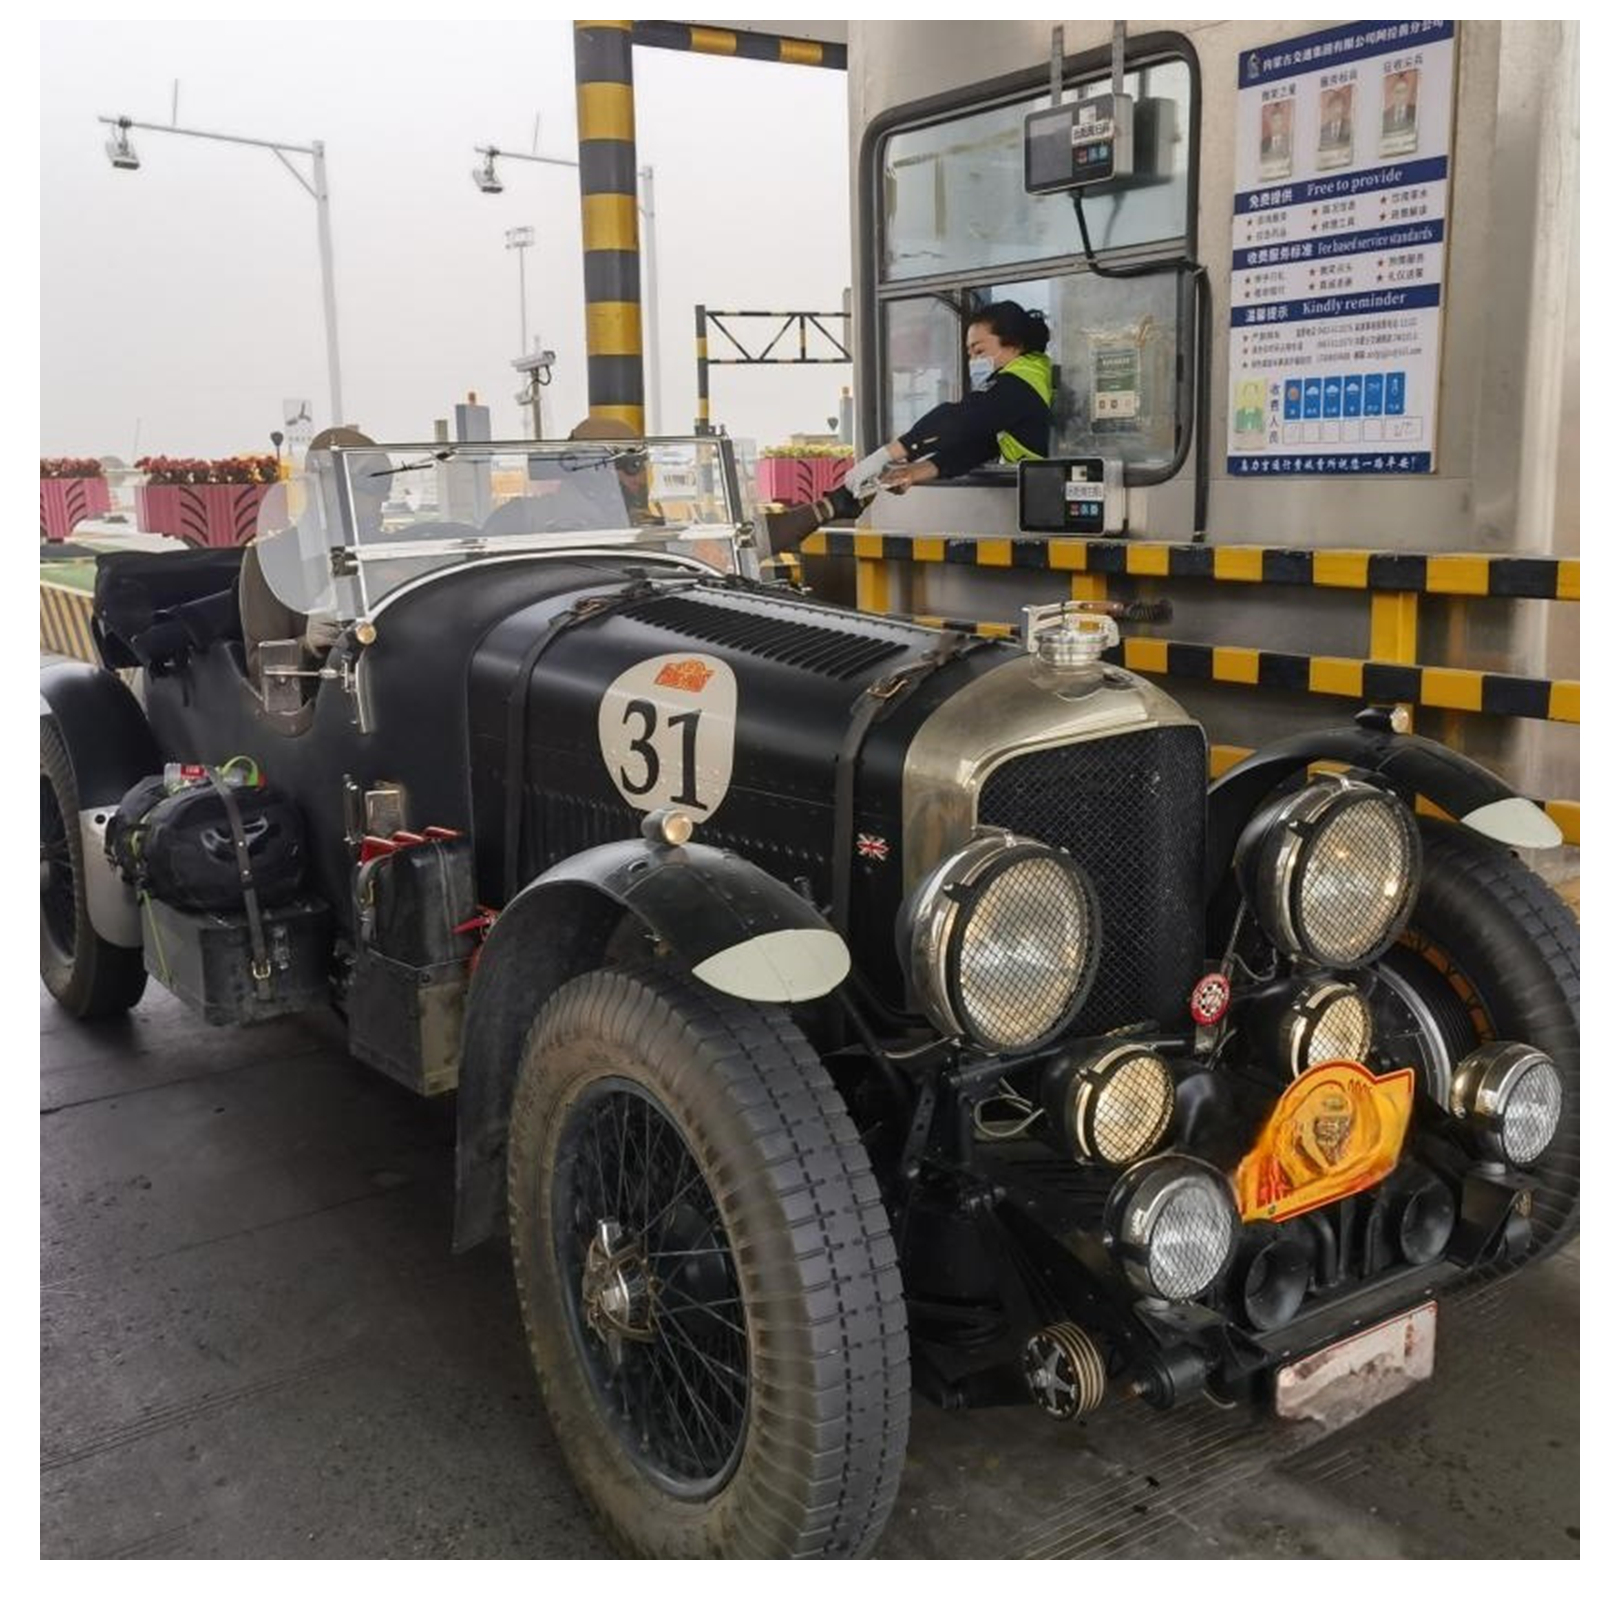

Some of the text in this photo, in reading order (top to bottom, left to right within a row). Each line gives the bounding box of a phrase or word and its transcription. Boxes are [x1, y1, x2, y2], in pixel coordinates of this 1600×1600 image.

[1249, 167, 1403, 210] 免费提供 Free to provide
[1247, 242, 1313, 266] 收费服务标准
[1358, 233, 1388, 248] service
[1389, 226, 1433, 243] standards
[1303, 297, 1341, 316] Kindly
[1345, 292, 1407, 310] reminder
[620, 697, 708, 811] 31
